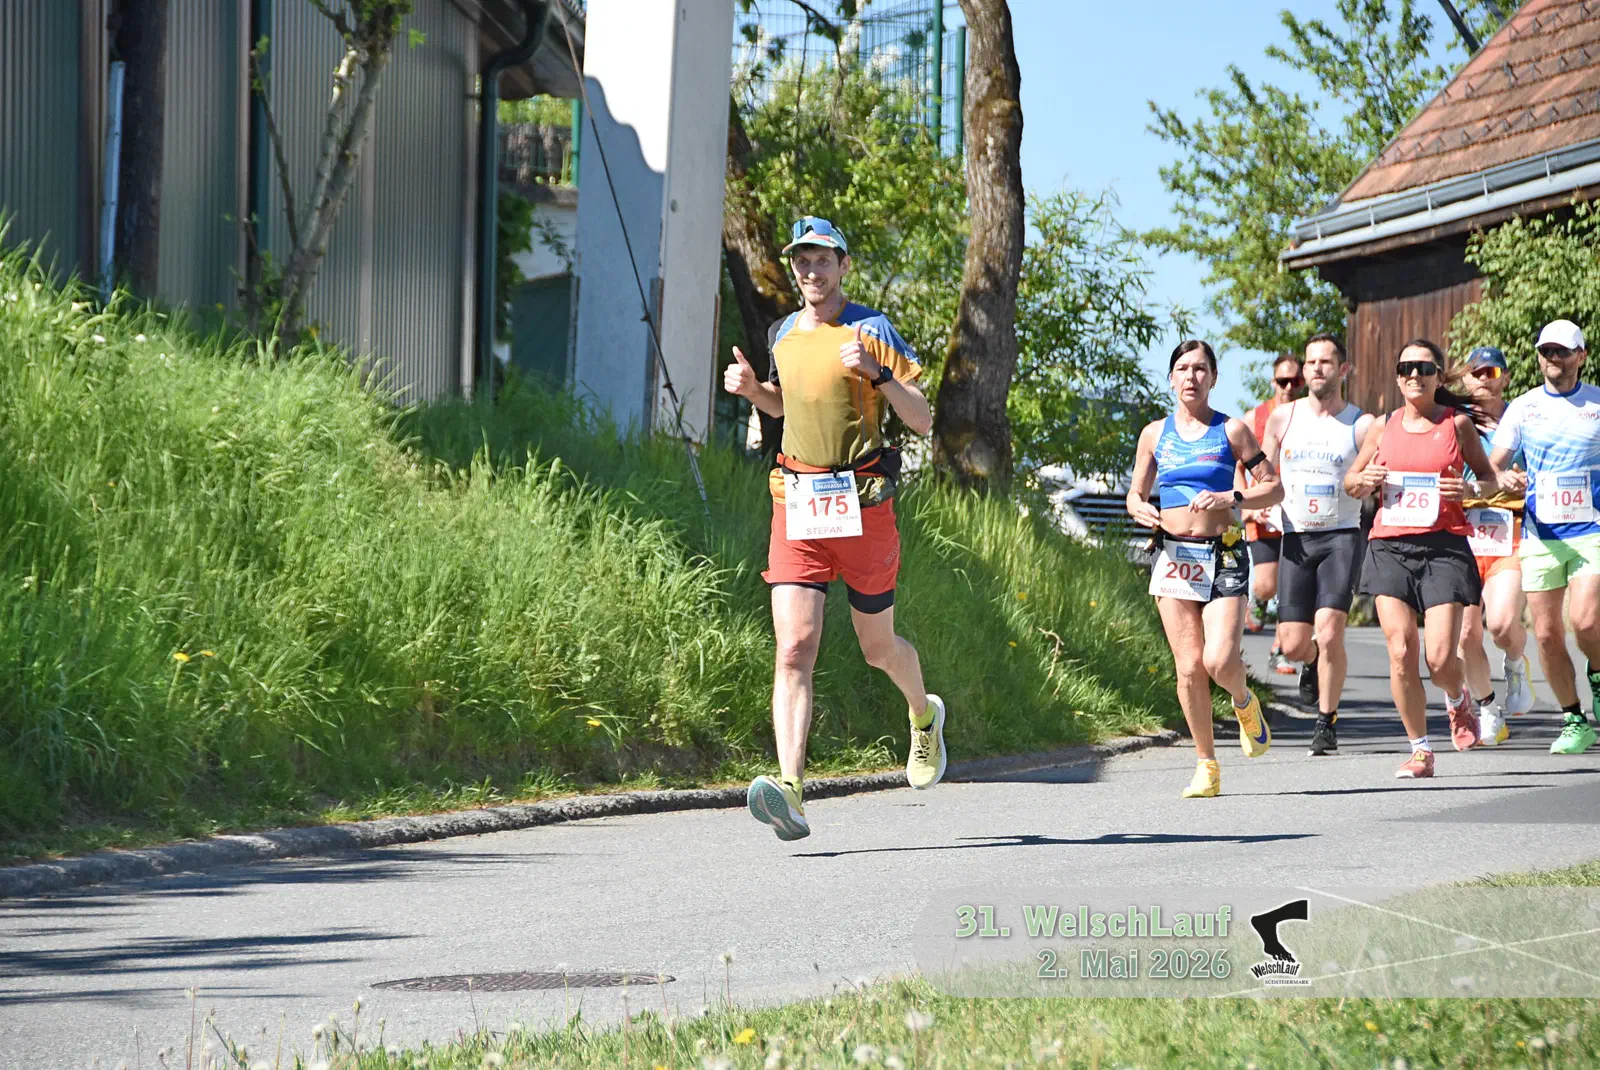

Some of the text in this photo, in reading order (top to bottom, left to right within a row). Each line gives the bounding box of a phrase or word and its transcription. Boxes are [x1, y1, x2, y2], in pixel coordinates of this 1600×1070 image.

[807, 495, 849, 517] 175
[1308, 499, 1319, 514] 5
[1394, 491, 1430, 509] 126
[1552, 489, 1584, 507] 104
[806, 526, 843, 536] STEFAN
[1477, 525, 1499, 540] 87
[1165, 561, 1205, 583] 202
